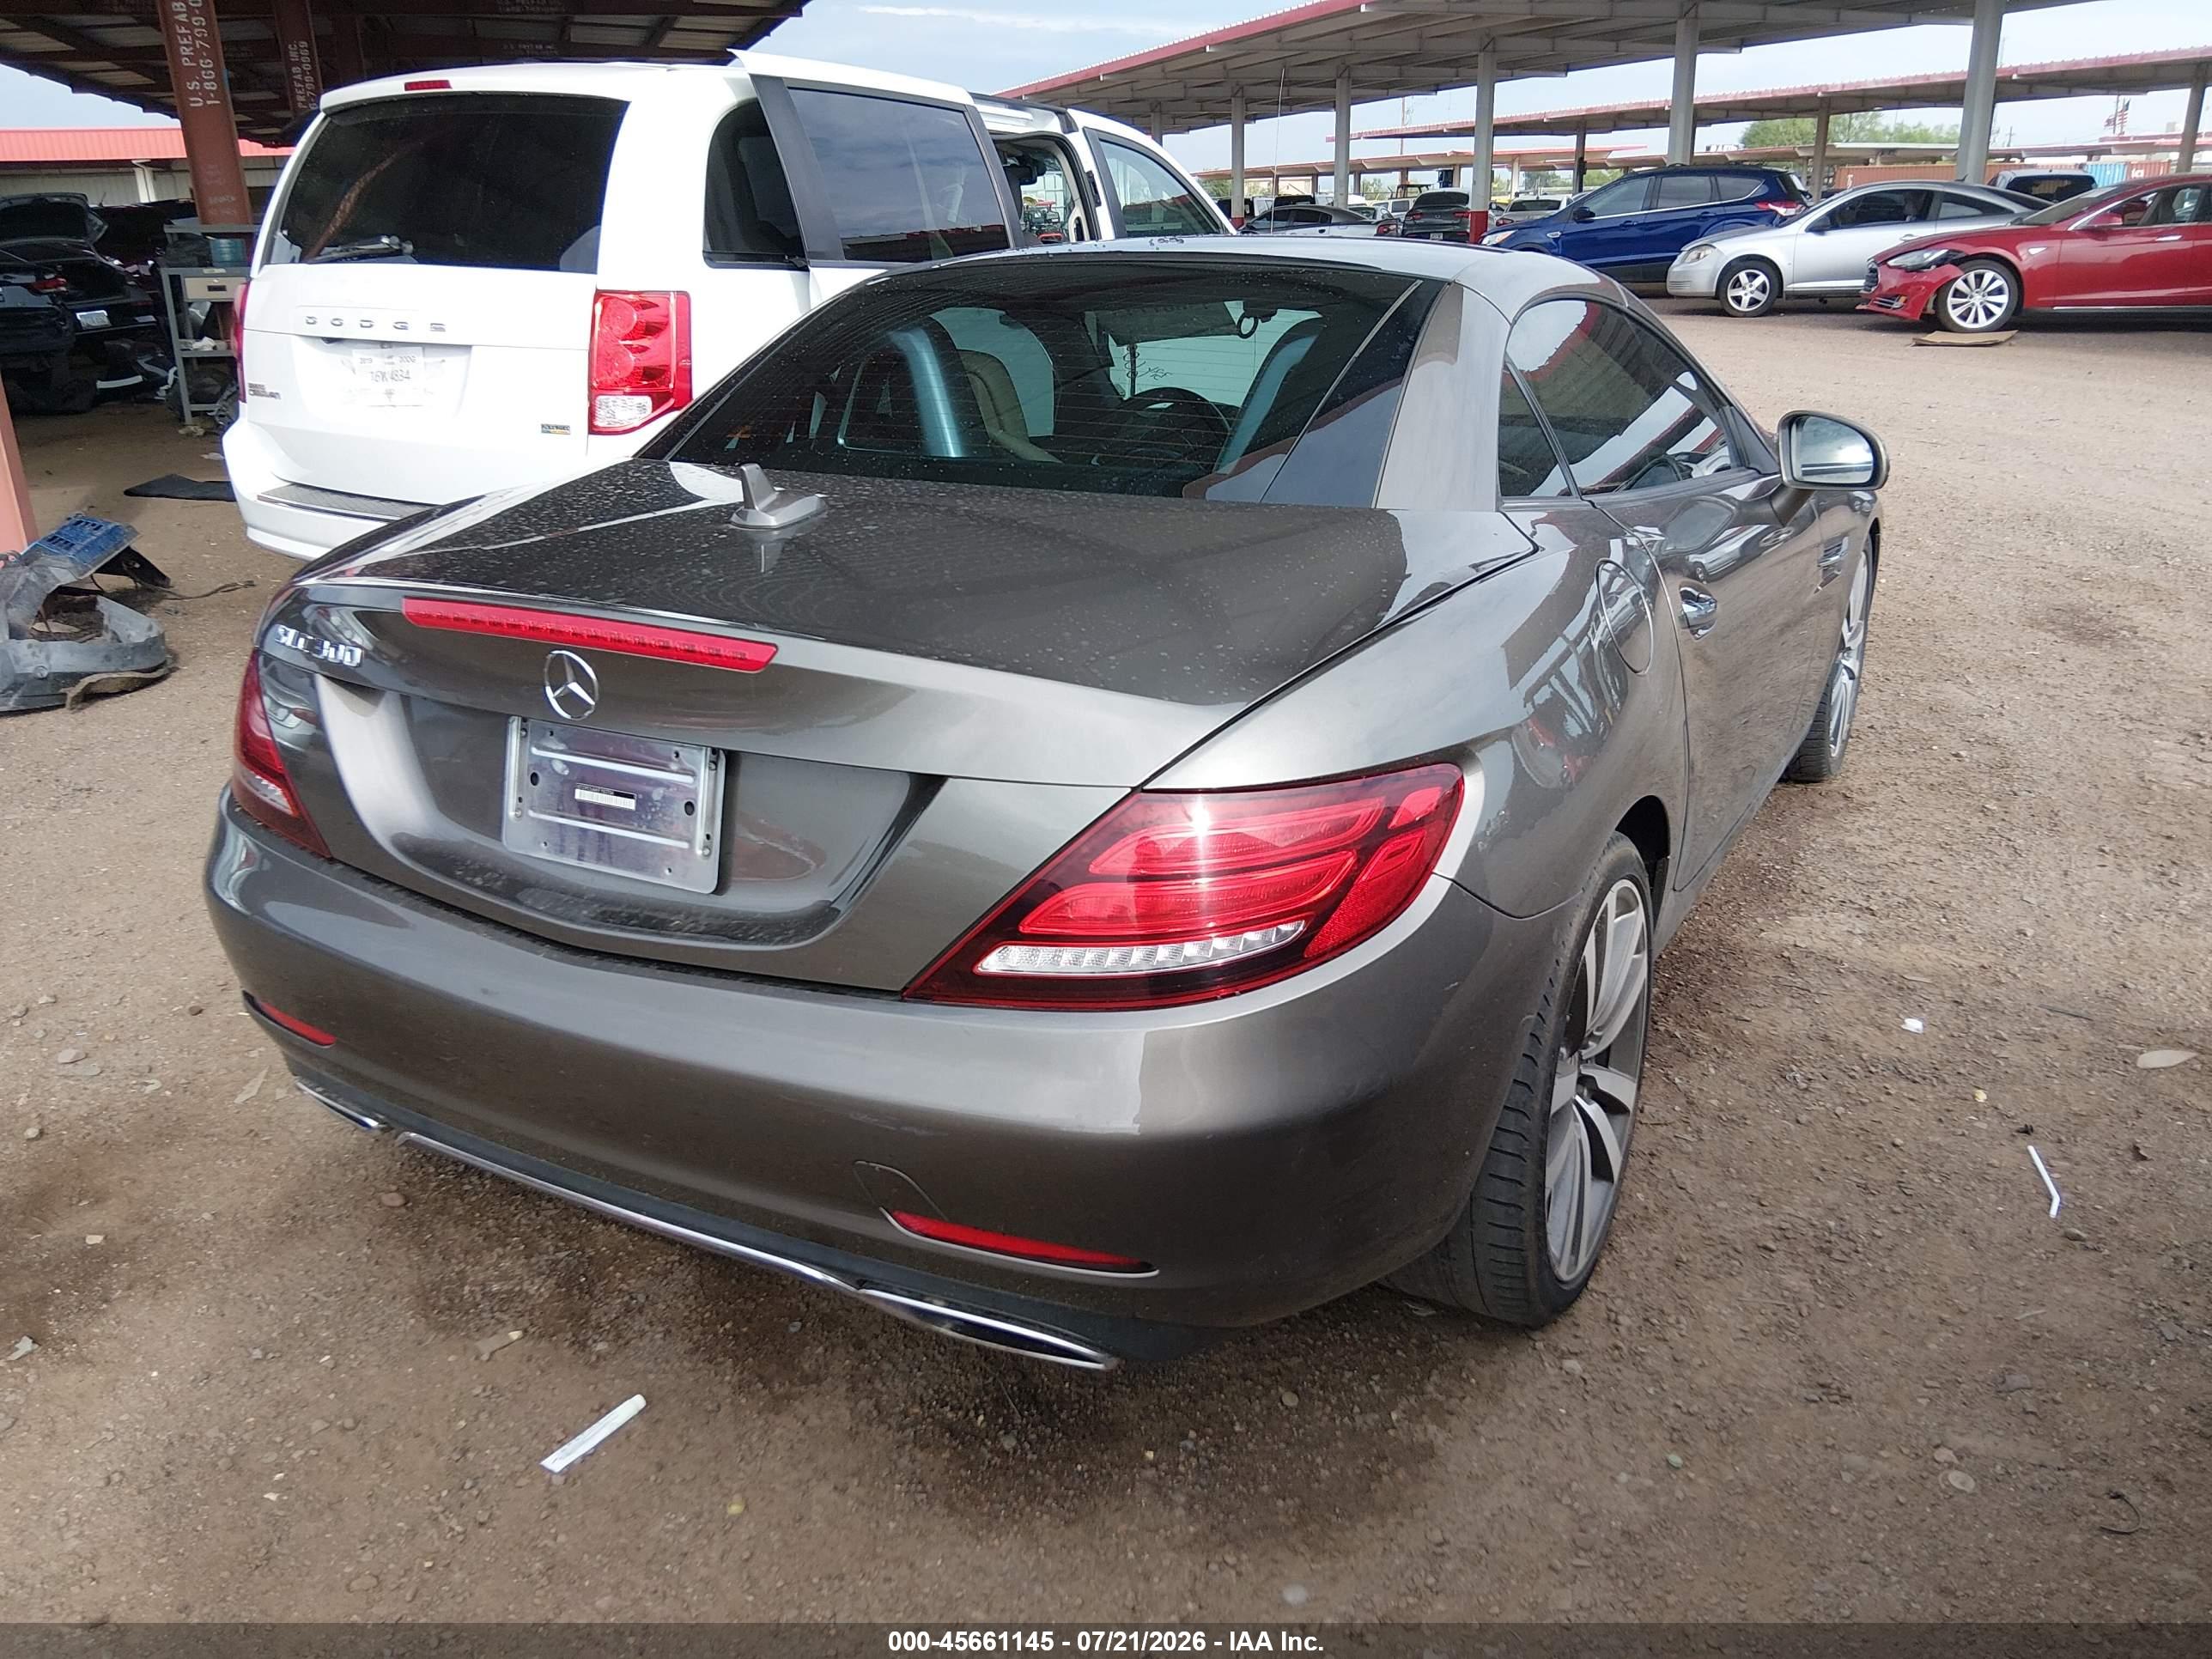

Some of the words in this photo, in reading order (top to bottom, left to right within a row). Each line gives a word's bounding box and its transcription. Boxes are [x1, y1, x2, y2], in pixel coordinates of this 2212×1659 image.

[172, 1, 198, 67] PREFAB
[185, 76, 204, 107] U.S.
[292, 66, 308, 109] PREFAB
[305, 315, 447, 332] DODGE
